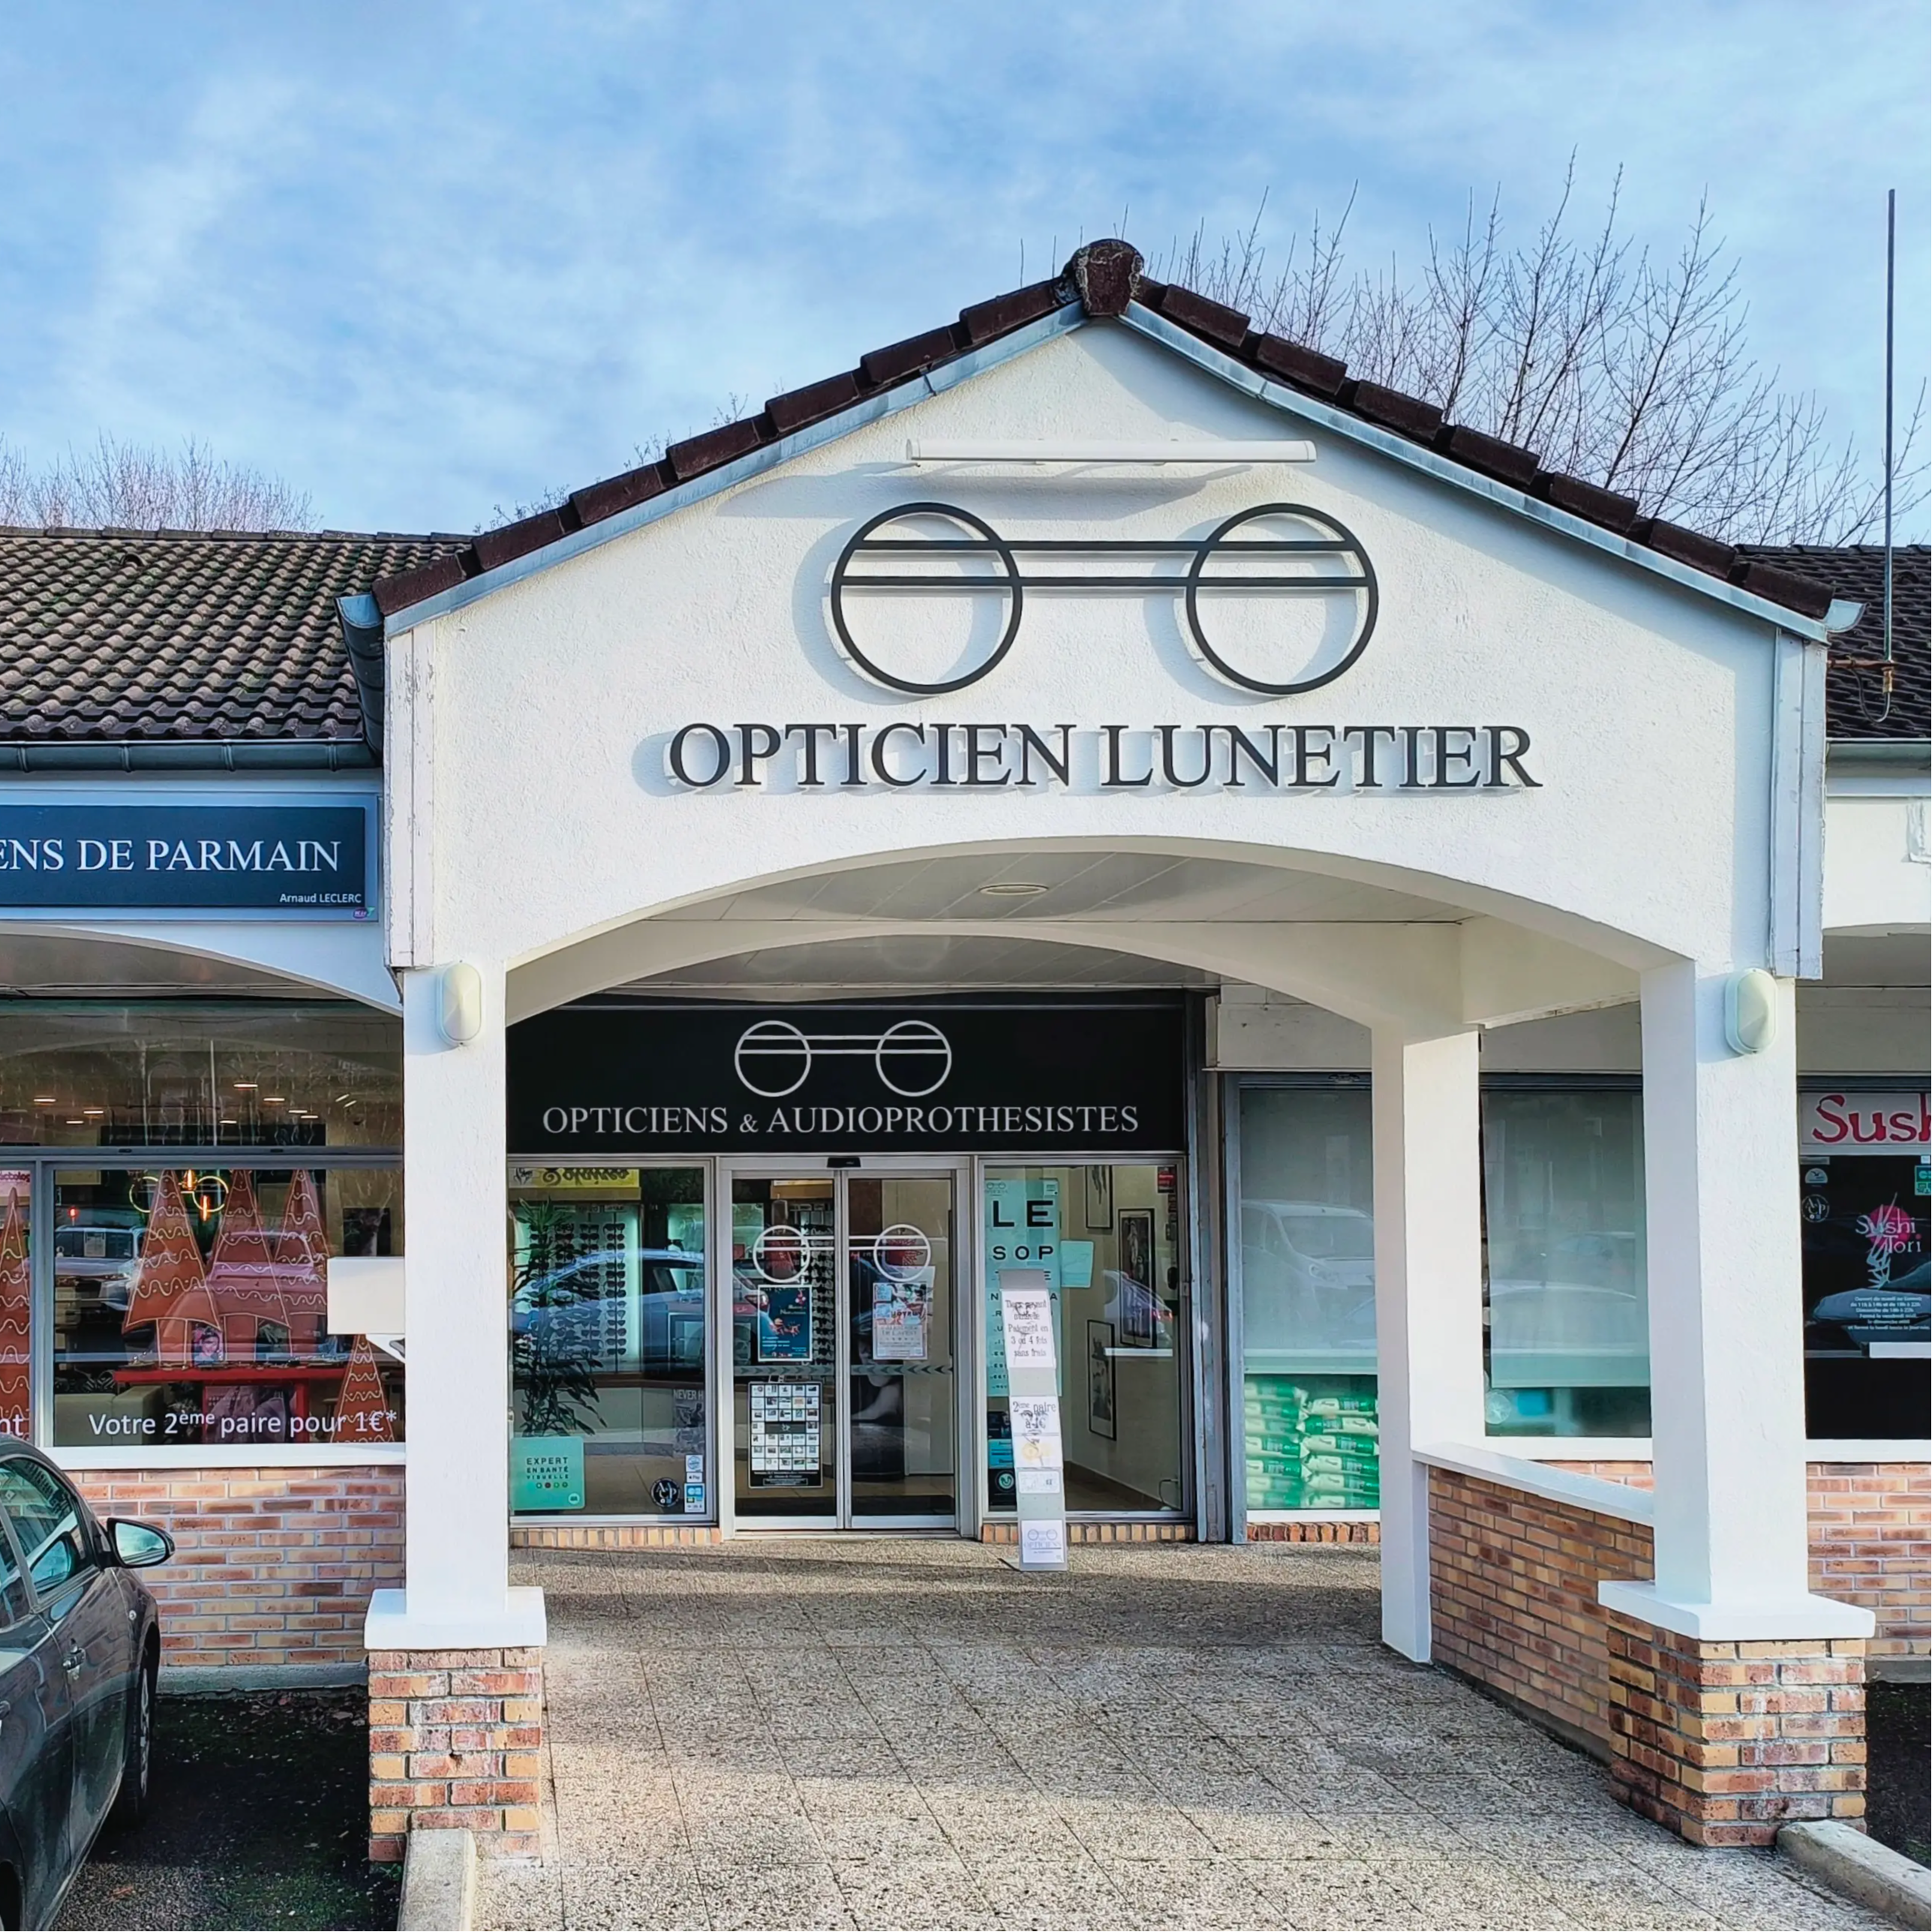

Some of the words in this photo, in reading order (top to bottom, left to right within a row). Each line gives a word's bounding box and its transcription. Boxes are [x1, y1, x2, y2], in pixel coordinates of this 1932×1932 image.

[670, 722, 1077, 787] OPTICIEN
[1100, 724, 1543, 787] LUNETIER
[77, 840, 134, 871] DE
[146, 840, 341, 872] PARMAIN
[280, 893, 317, 903] Arnaud
[319, 894, 362, 903] LECLERC
[542, 1107, 728, 1133] OPTICIENS
[739, 1113, 759, 1133] &
[766, 1106, 1138, 1133] AUDIOPROTHESISTES
[1855, 1208, 1916, 1234] Sushi
[1883, 1234, 1921, 1254] Tori
[1011, 1336, 1016, 1345] 3
[674, 1389, 696, 1400] NEVER
[89, 1414, 155, 1435] Votre
[164, 1410, 215, 1434] 2ème
[221, 1412, 281, 1438] paire
[290, 1417, 344, 1438] pour
[527, 1457, 568, 1465] EXPERT
